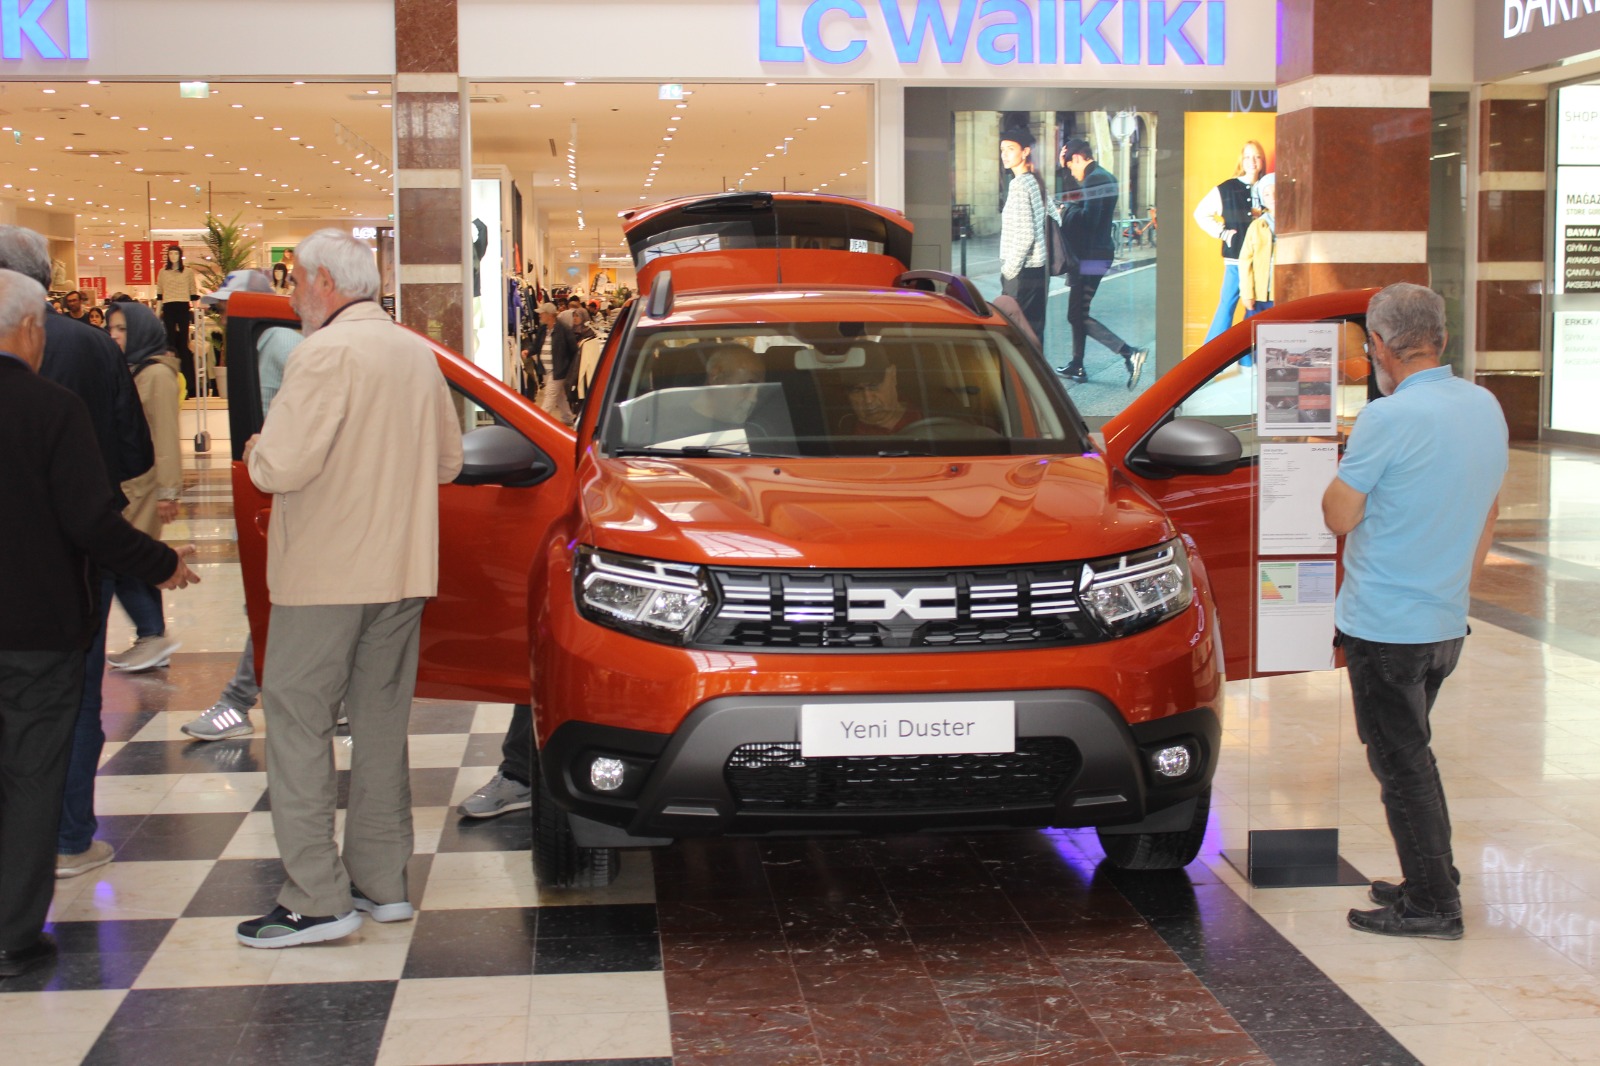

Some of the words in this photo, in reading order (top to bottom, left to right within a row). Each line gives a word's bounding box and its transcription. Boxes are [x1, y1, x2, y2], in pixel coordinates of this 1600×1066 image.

[758, 0, 868, 65] LC
[840, 719, 888, 739] Yeni
[898, 719, 976, 738] Duster
